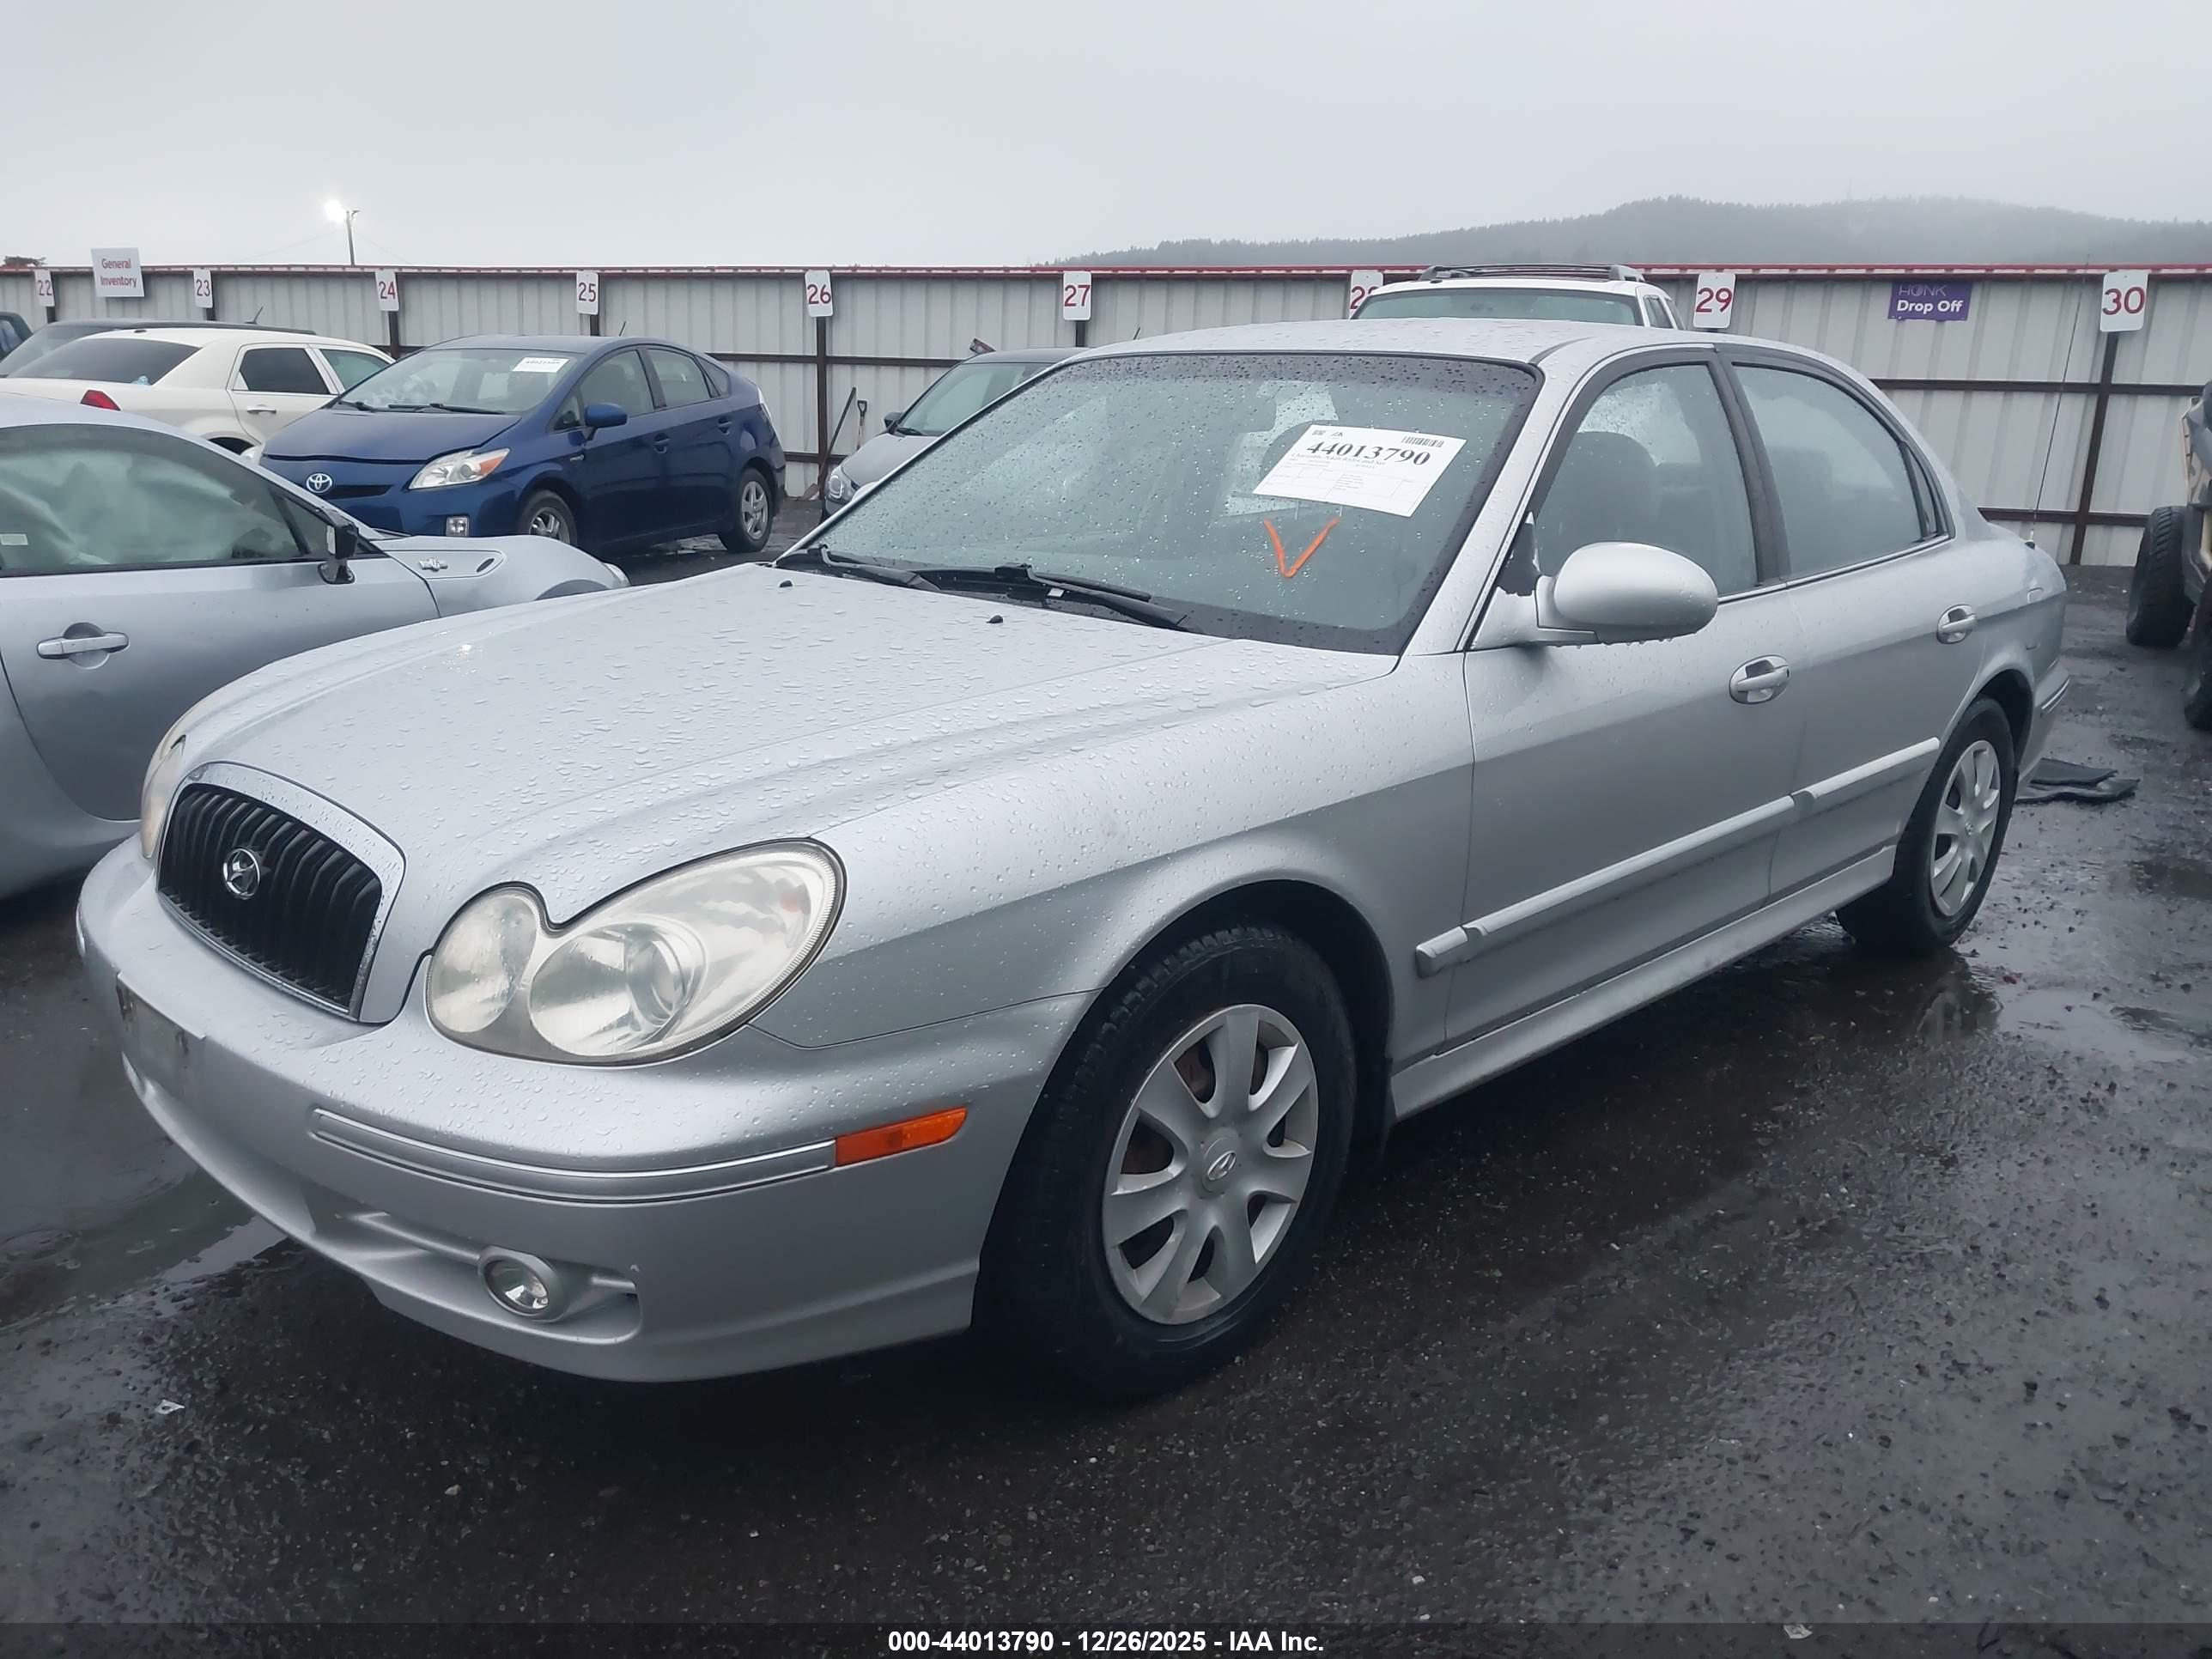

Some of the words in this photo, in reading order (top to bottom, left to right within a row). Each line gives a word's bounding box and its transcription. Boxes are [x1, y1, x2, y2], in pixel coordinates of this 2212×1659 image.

[101, 258, 132, 269] General
[37, 279, 52, 296] 22
[100, 276, 137, 289] Inventory
[196, 279, 210, 297] 23
[378, 281, 396, 300] 24
[578, 282, 597, 302] 25
[1899, 284, 1947, 297] HONK
[806, 284, 831, 305] 26
[1064, 284, 1091, 307] 27
[1695, 287, 1733, 313] 29
[2102, 286, 2145, 316] 30
[1896, 300, 1934, 315] Drop
[1937, 300, 1964, 313] Off
[1306, 441, 1431, 466] 44013790
